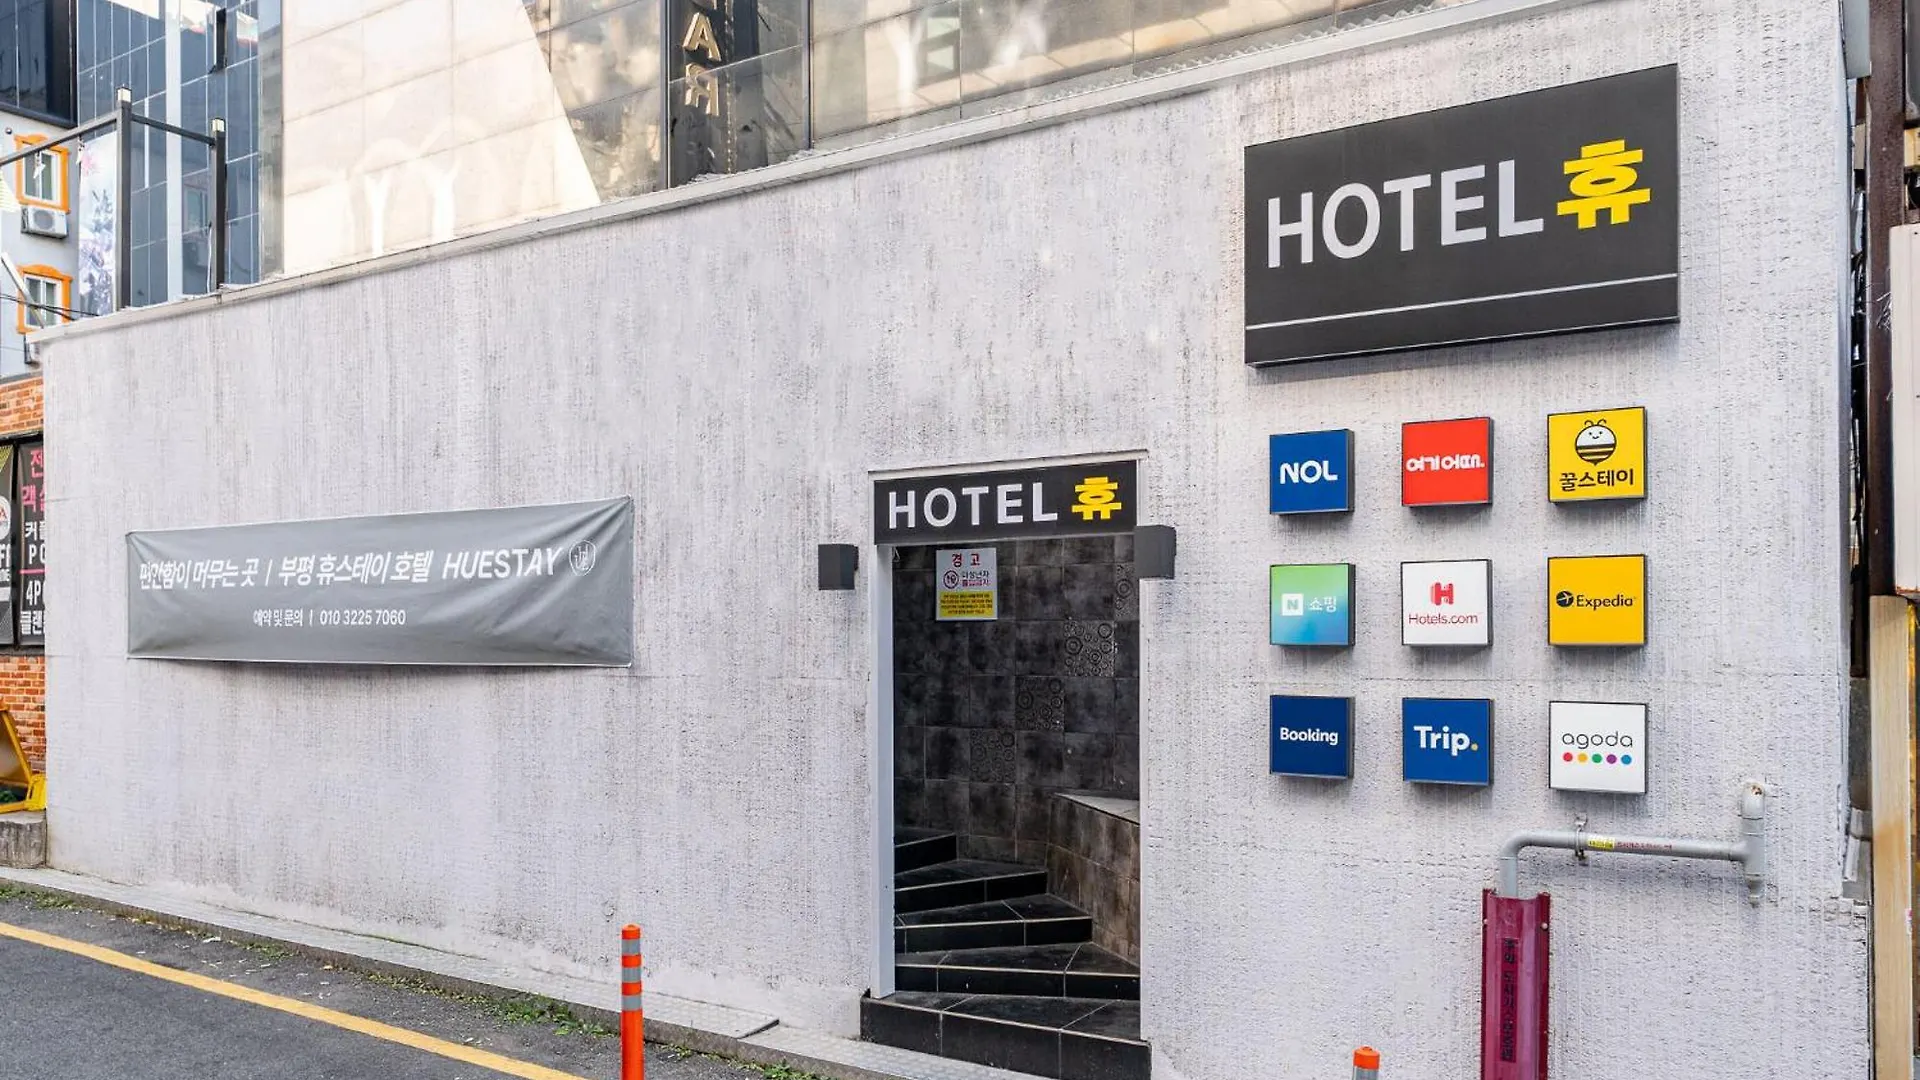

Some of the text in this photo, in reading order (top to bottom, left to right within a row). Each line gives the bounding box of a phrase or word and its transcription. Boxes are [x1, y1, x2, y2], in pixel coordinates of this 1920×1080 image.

[1267, 139, 1651, 269] HOTEL 휴
[1279, 460, 1338, 485] NOL
[1559, 468, 1635, 492] 꿀스테이
[888, 476, 1122, 530] HOTEL 휴
[192, 559, 239, 589] 머무는
[240, 558, 259, 587] 곳
[278, 554, 316, 586] 부평
[316, 551, 390, 585] 휴스테이
[390, 550, 434, 583] 호텔
[442, 547, 564, 580] HUESTAY
[1308, 596, 1337, 613] 쇼핑
[1576, 593, 1634, 611] Expedia
[253, 608, 271, 627] 예약
[273, 608, 283, 627] 및
[284, 608, 303, 627] 문의
[320, 609, 340, 626] 010
[343, 609, 372, 626] 3225
[375, 609, 406, 625] 7060
[1408, 612, 1478, 625] Hotels.com
[1279, 727, 1338, 746] Booking
[1561, 731, 1633, 750] agoda
